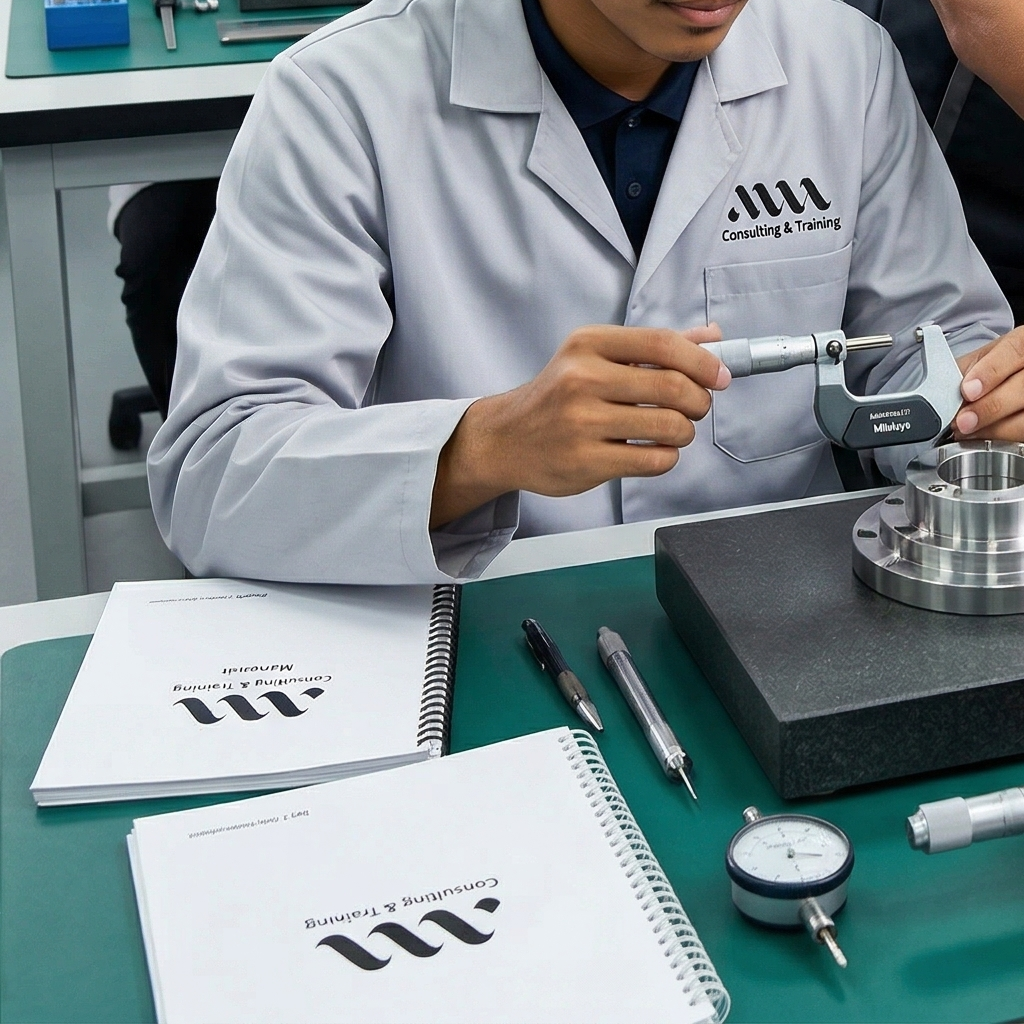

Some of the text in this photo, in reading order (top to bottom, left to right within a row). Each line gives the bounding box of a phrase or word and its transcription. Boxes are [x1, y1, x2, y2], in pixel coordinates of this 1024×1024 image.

[722, 216, 842, 242] Consulting & Training
[304, 877, 499, 930] Consulting & Training
